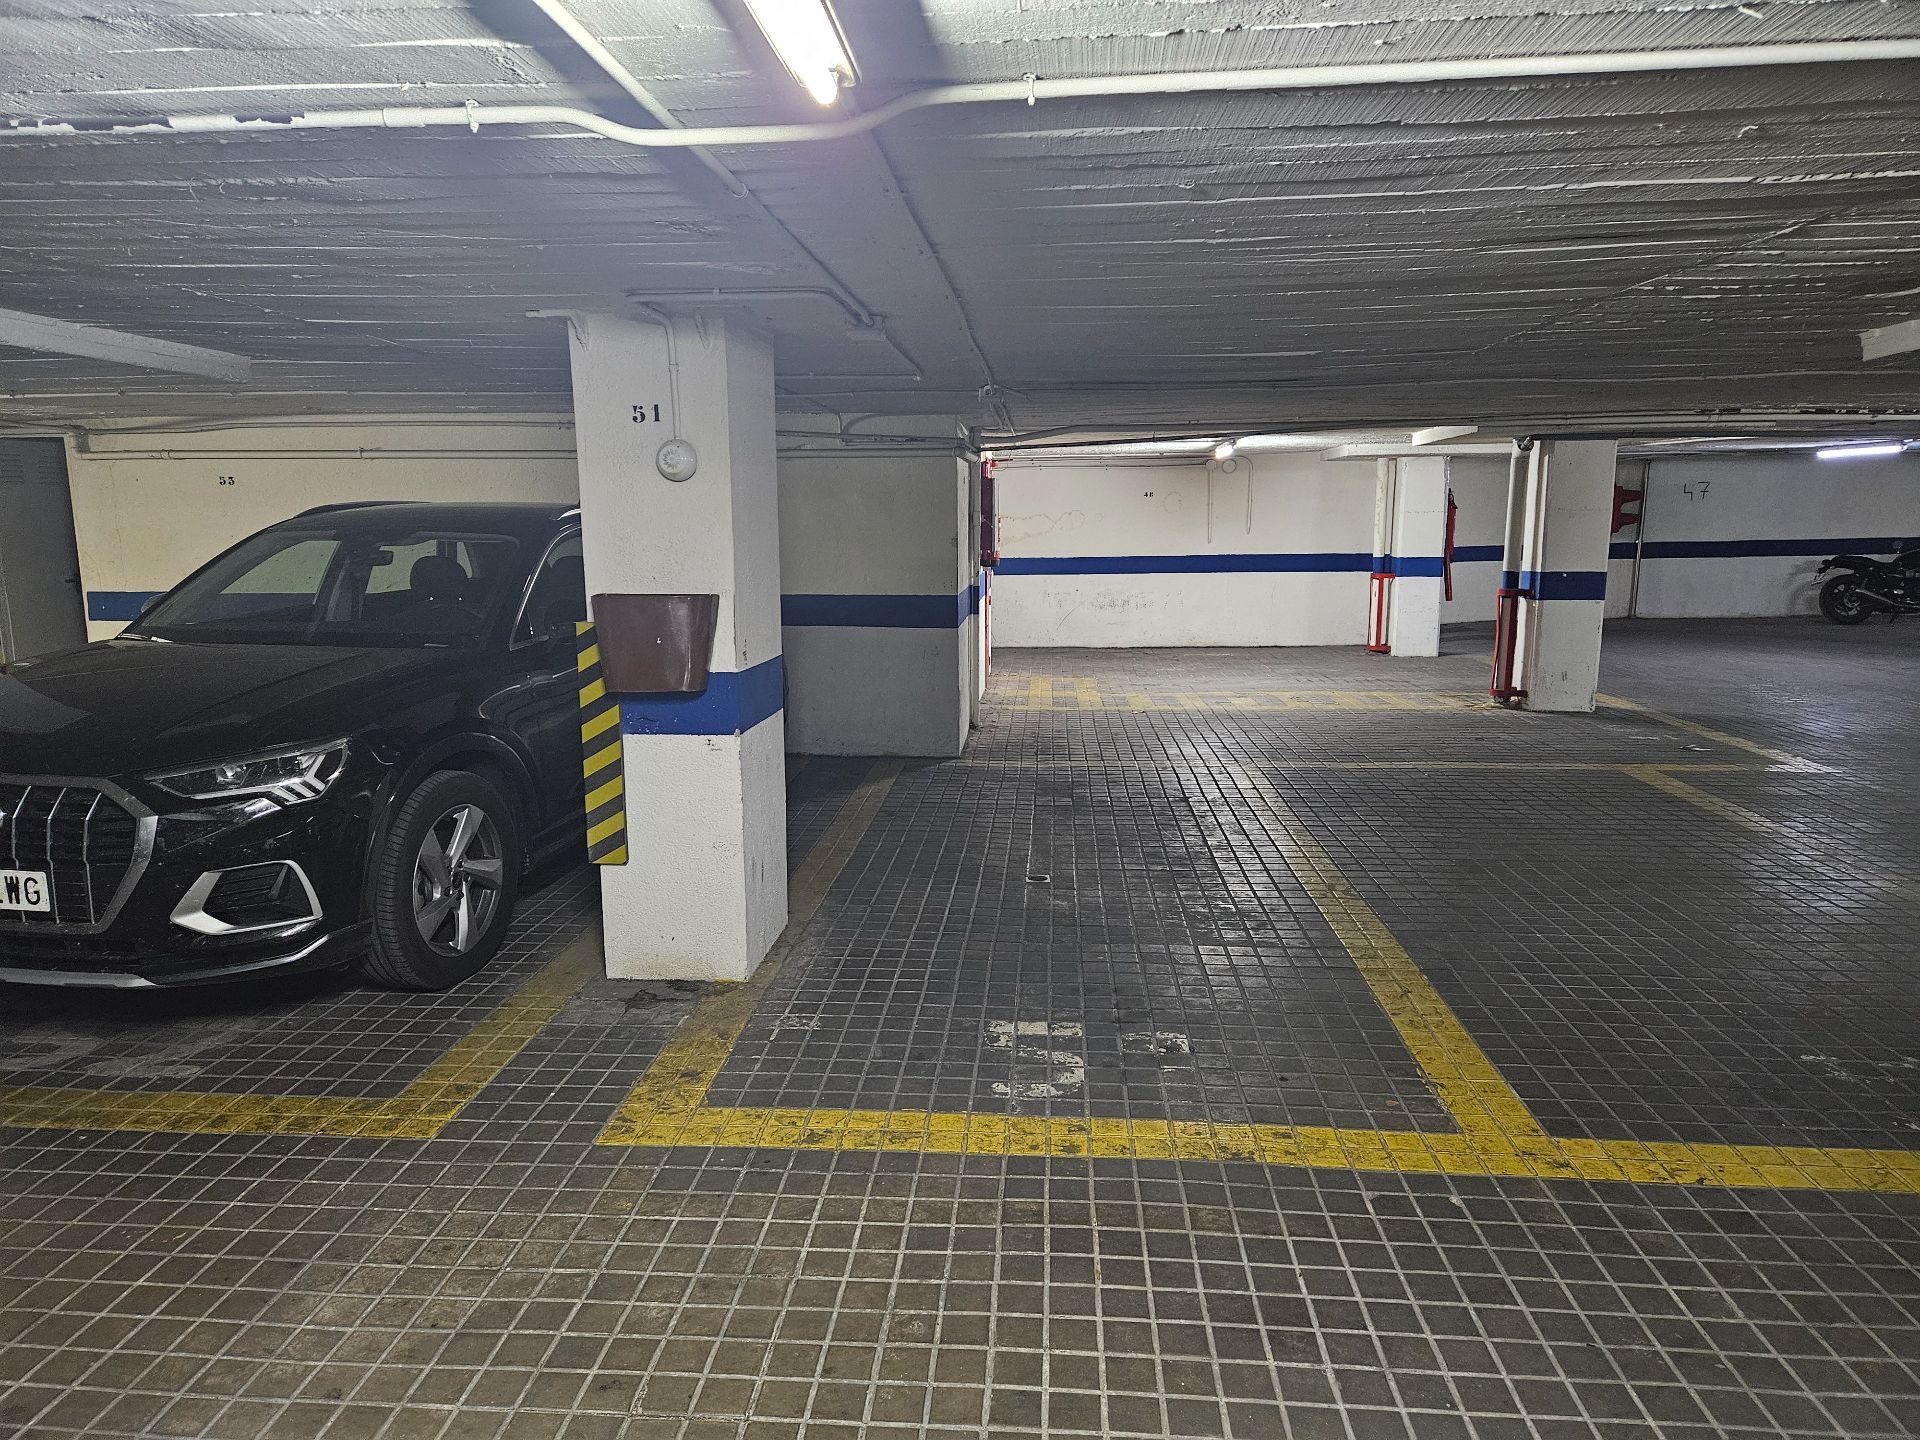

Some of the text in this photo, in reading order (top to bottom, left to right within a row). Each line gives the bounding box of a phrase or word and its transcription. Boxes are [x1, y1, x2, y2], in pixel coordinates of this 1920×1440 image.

[632, 404, 660, 423] 51
[219, 476, 235, 485] 53
[1684, 482, 1710, 501] 47
[0, 875, 41, 905] WG
